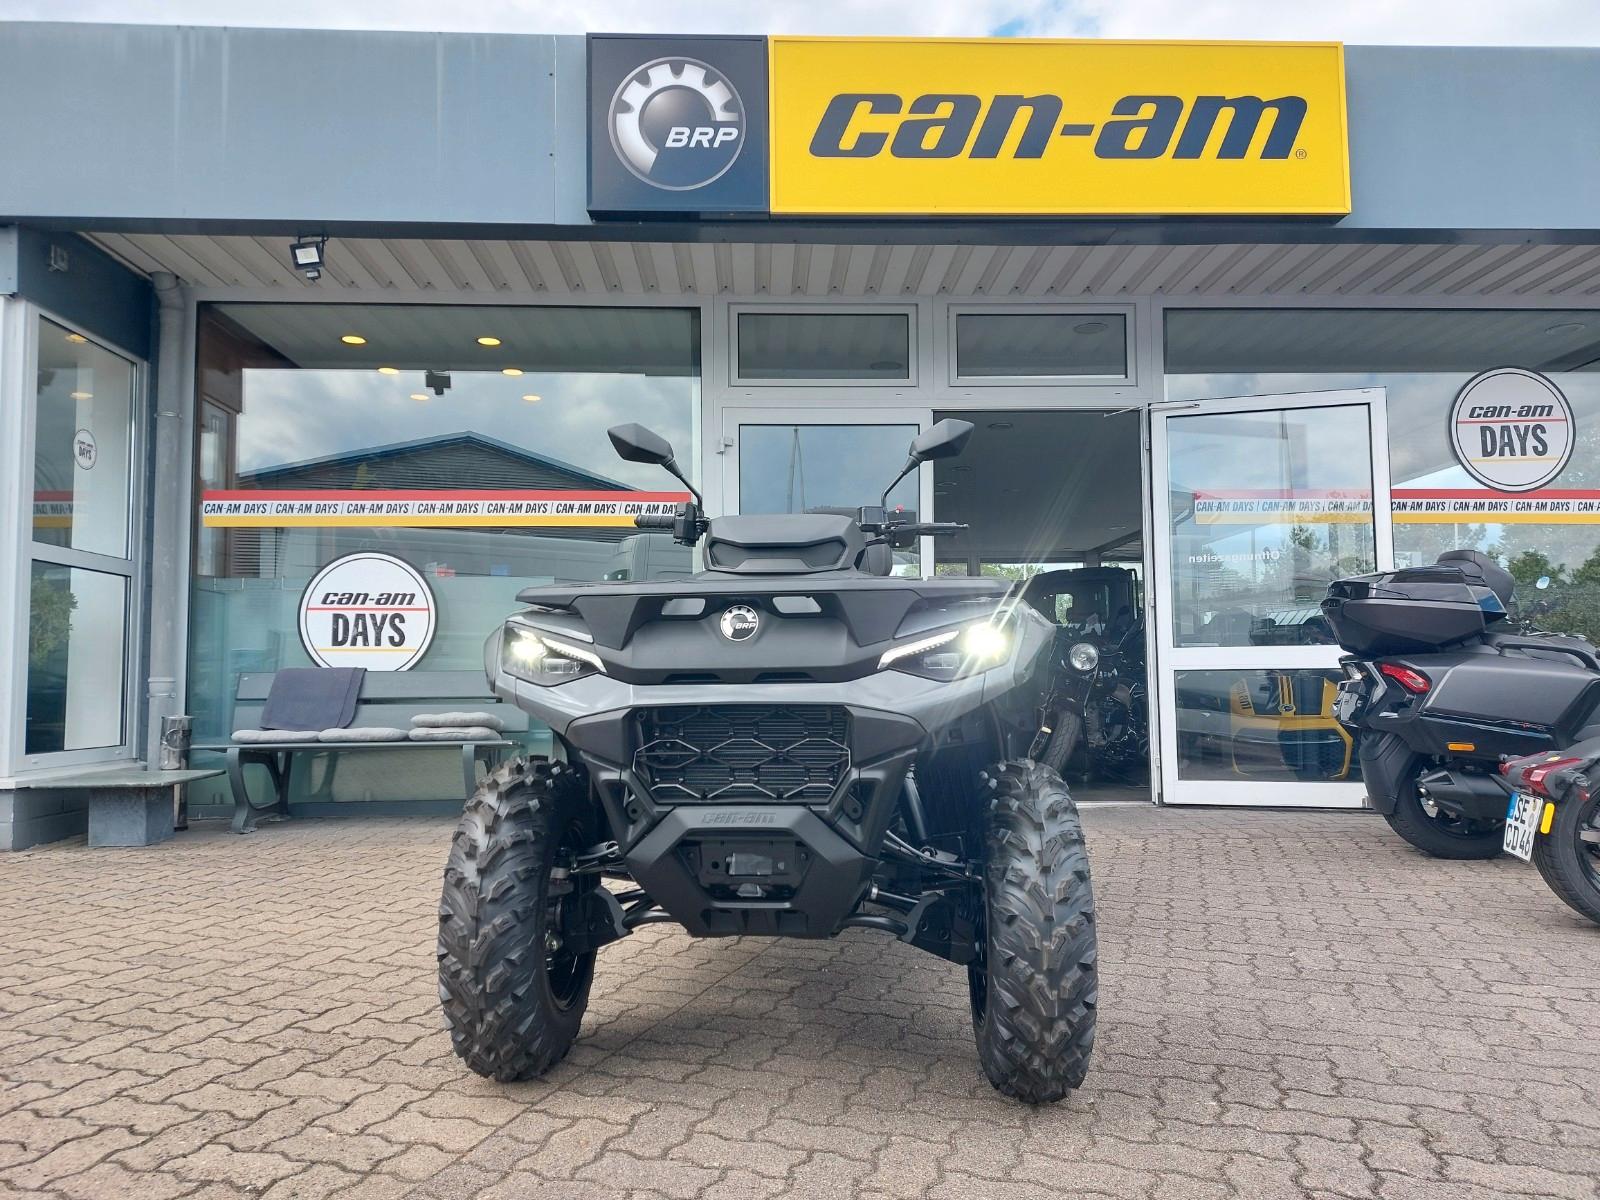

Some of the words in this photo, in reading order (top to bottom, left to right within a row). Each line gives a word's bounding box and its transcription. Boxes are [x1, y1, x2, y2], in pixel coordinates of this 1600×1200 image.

[665, 127, 739, 148] BRP
[1469, 405, 1553, 418] can-am
[1480, 424, 1548, 457] DAYS
[204, 503, 241, 514] CAN-AM
[243, 503, 267, 514] DAYS
[275, 503, 312, 514] CAN-AM
[314, 503, 338, 514] DAYS
[346, 503, 383, 514] CAN-AM
[385, 503, 409, 514] DAYS
[417, 503, 453, 514] CAN-AM
[456, 503, 479, 514] DAYS
[487, 503, 522, 514] CAN-AM
[525, 503, 548, 514] DAYS
[556, 503, 591, 514] CAN-AM
[593, 503, 617, 514] DAYS
[624, 503, 660, 515] CAN-AM
[1196, 501, 1230, 512] CAN-AM
[1232, 501, 1254, 512] DAYS
[1262, 501, 1296, 512] CAN-AM
[1298, 501, 1321, 512] DAYS
[1328, 501, 1360, 512] CAN-AM
[1391, 501, 1423, 512] CAN-AM
[1425, 501, 1446, 512] DAYS
[1453, 501, 1485, 512] CAN-AM
[1487, 501, 1508, 512] DAYS
[1515, 501, 1547, 512] CAN-AM
[1549, 501, 1570, 512] DAYS
[1577, 501, 1600, 512] CAN-A
[321, 592, 416, 606] can-am
[331, 613, 406, 647] DAYS
[735, 622, 757, 630] BRP
[1514, 796, 1530, 825] SE
[702, 812, 777, 824] can-am
